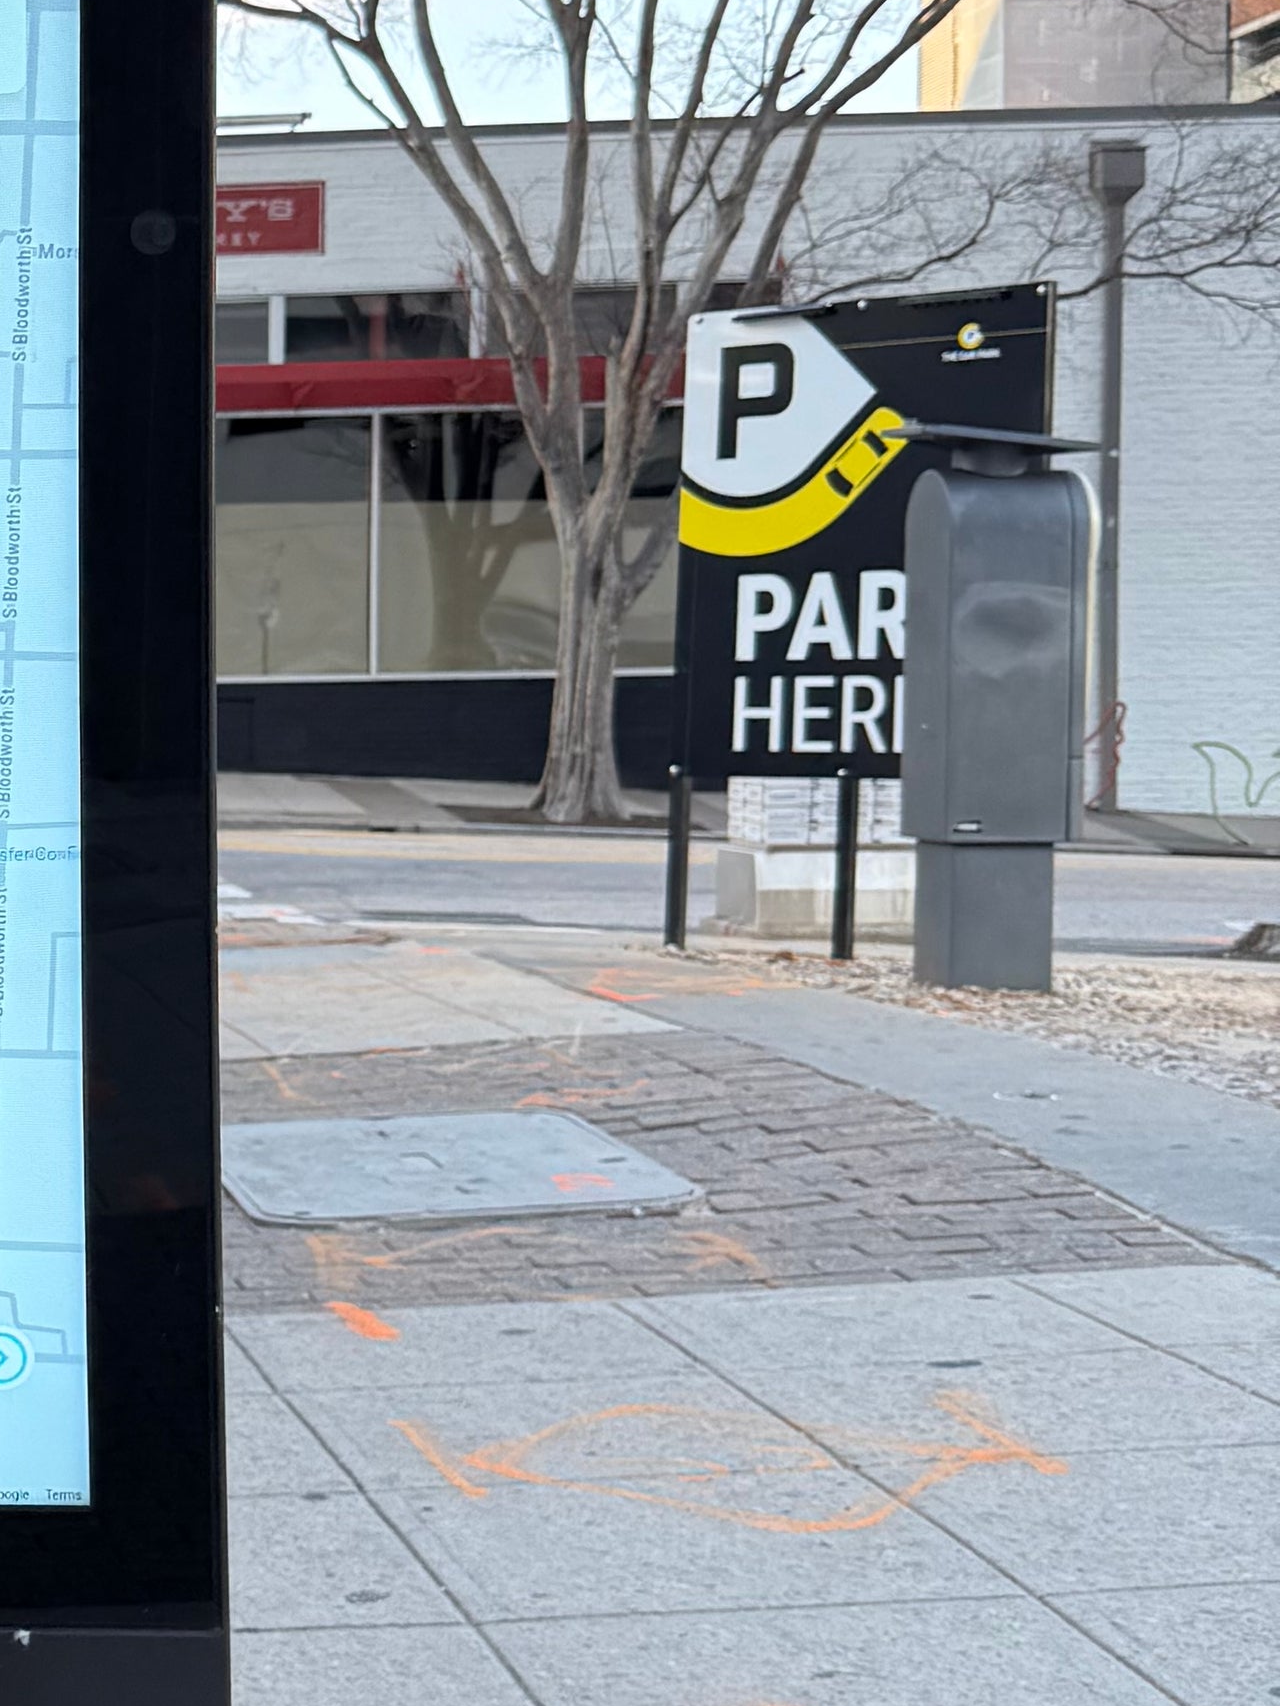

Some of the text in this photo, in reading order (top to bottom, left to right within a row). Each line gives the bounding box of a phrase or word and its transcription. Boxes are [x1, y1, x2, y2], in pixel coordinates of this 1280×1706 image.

[13, 227, 33, 346] Bloodworth St
[717, 342, 794, 460] P
[3, 488, 23, 604] Bloodworth St
[0, 688, 16, 705] St
[730, 674, 906, 753] HER
[46, 1488, 83, 1500] Terms
